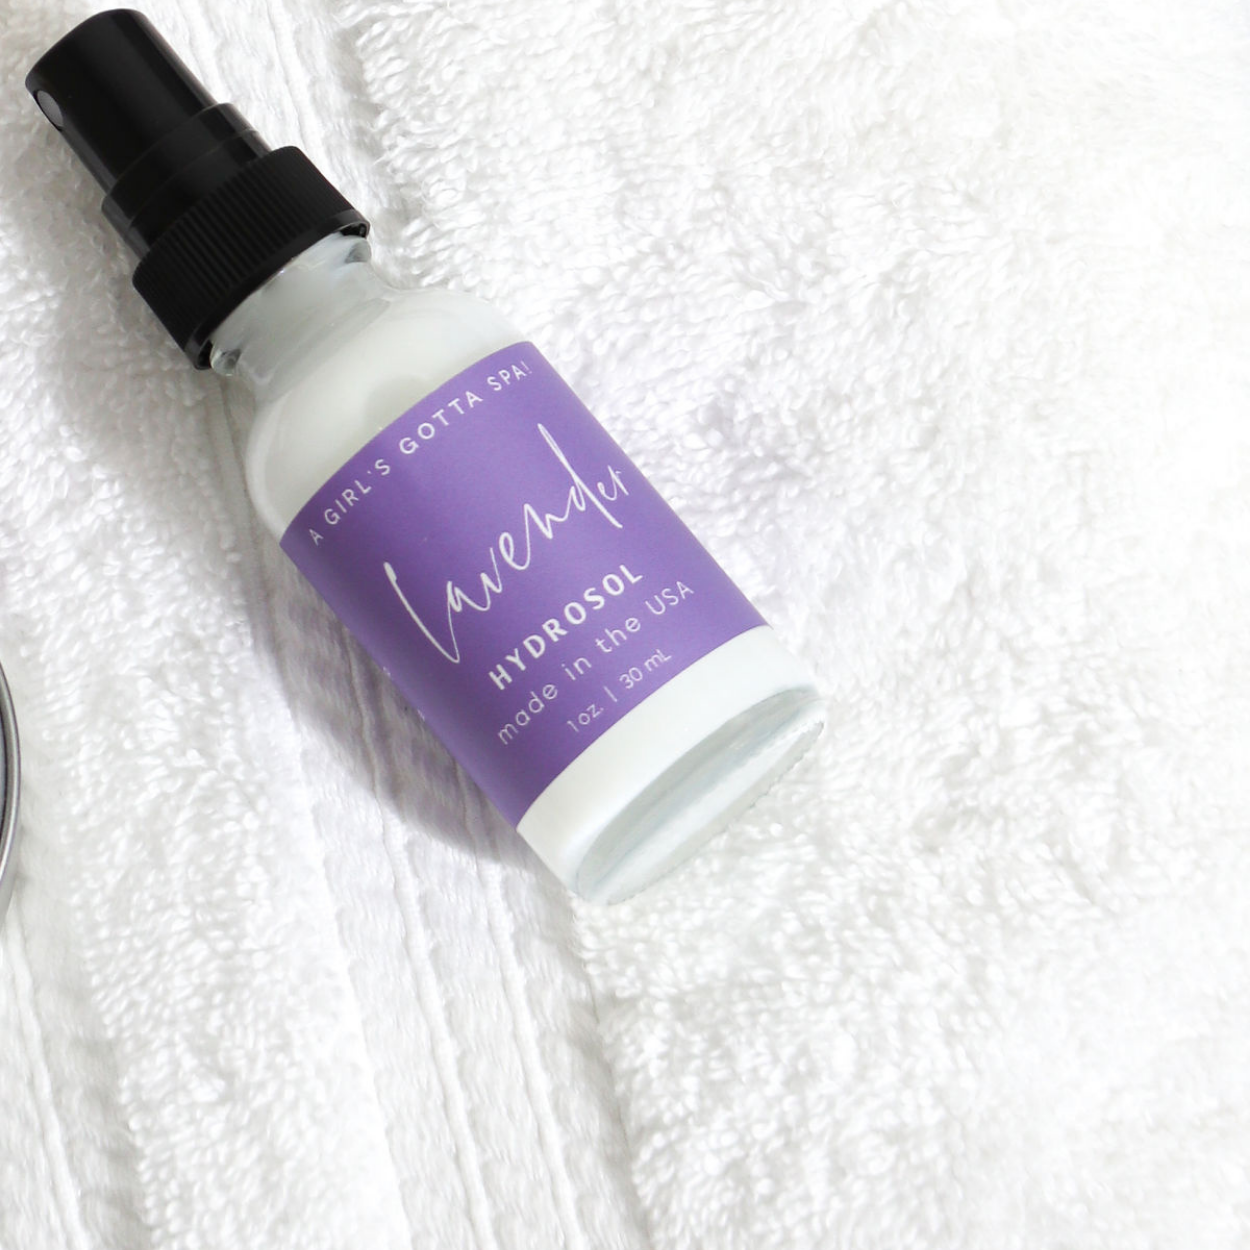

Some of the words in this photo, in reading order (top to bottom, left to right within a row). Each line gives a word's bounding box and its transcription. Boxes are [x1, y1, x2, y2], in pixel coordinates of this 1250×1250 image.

[309, 528, 324, 546] A
[324, 458, 391, 525] GIRL'S
[398, 390, 484, 455] GOTTA
[486, 360, 532, 392] SPA!
[488, 564, 643, 691] HYDROSOL
[497, 683, 559, 745] made
[561, 657, 592, 681] in
[595, 617, 642, 653] the
[644, 580, 694, 616] USA
[618, 666, 644, 690] 30
[643, 648, 672, 672] mL
